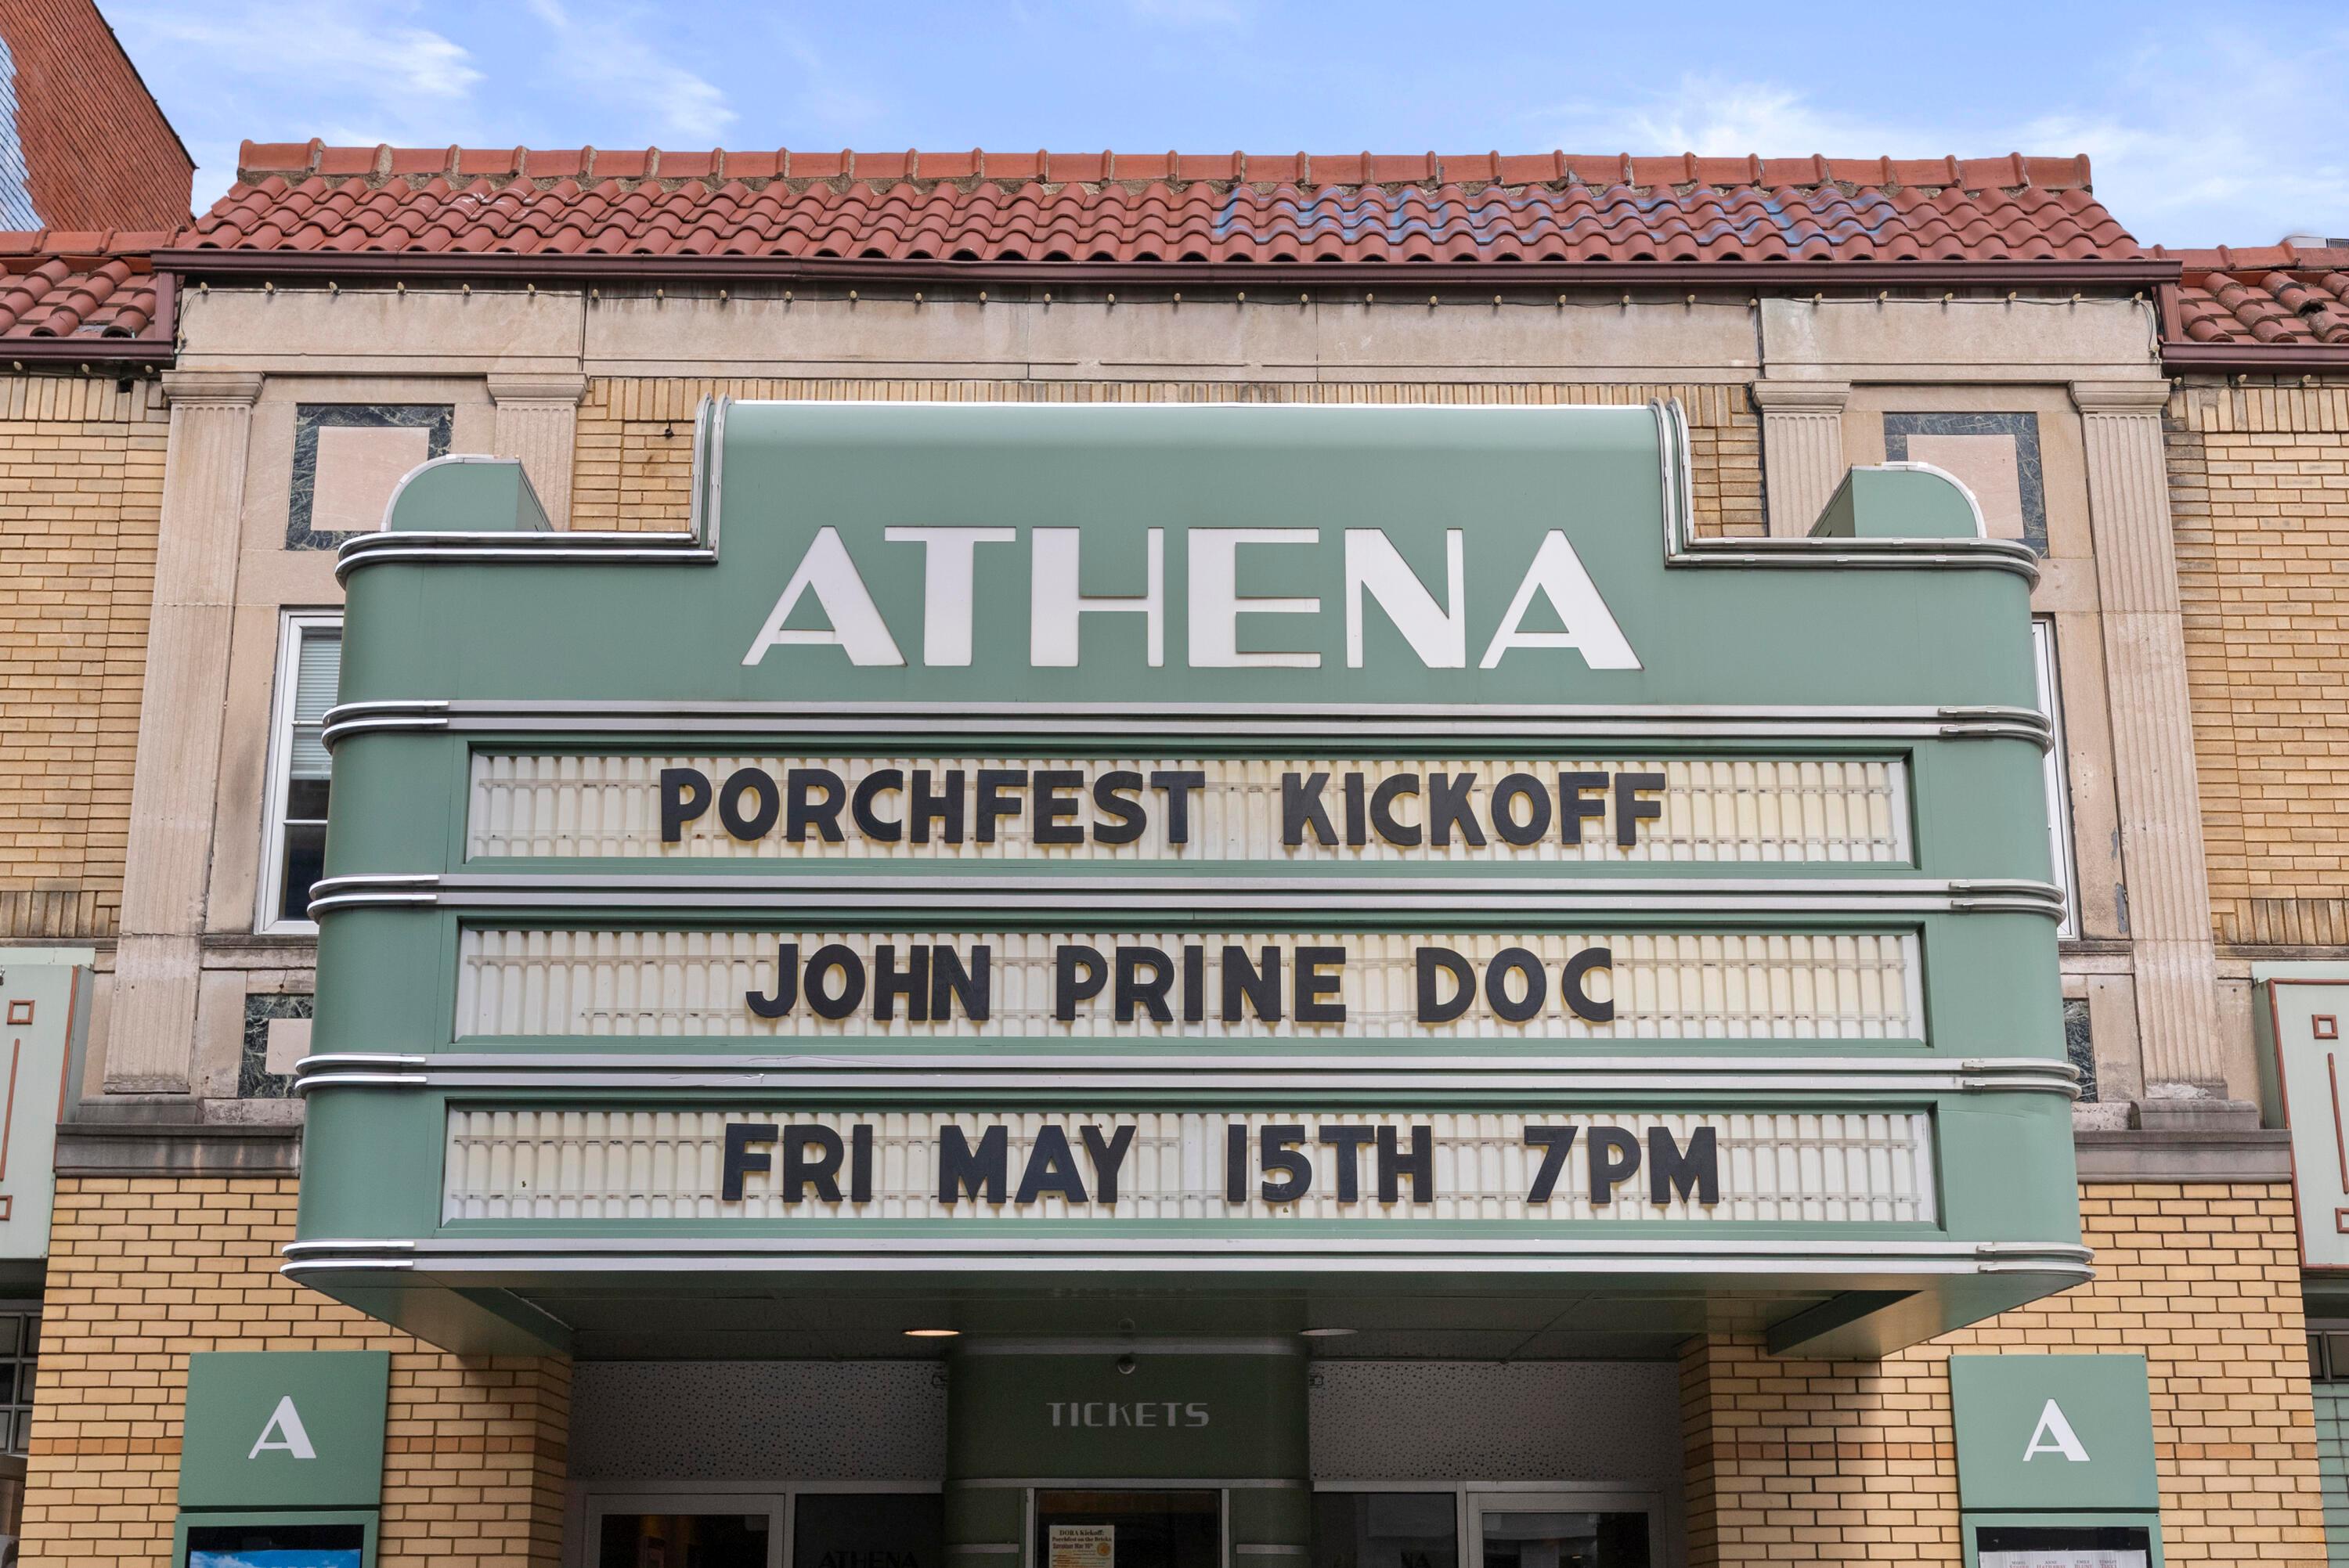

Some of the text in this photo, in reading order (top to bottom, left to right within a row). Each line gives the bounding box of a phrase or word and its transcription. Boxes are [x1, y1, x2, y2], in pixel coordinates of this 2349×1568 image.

[741, 527, 1644, 669] ATHENA
[660, 767, 1665, 846] PORCHFEST KICKOFF
[745, 943, 1615, 1023] JOHN PRINE DOC
[721, 1123, 1719, 1205] FRI MAY 15TH 7PM
[247, 1395, 317, 1459] A
[1046, 1402, 1209, 1427] TICKETS
[2022, 1399, 2091, 1462] A
[818, 1552, 919, 1568] ATHENA
